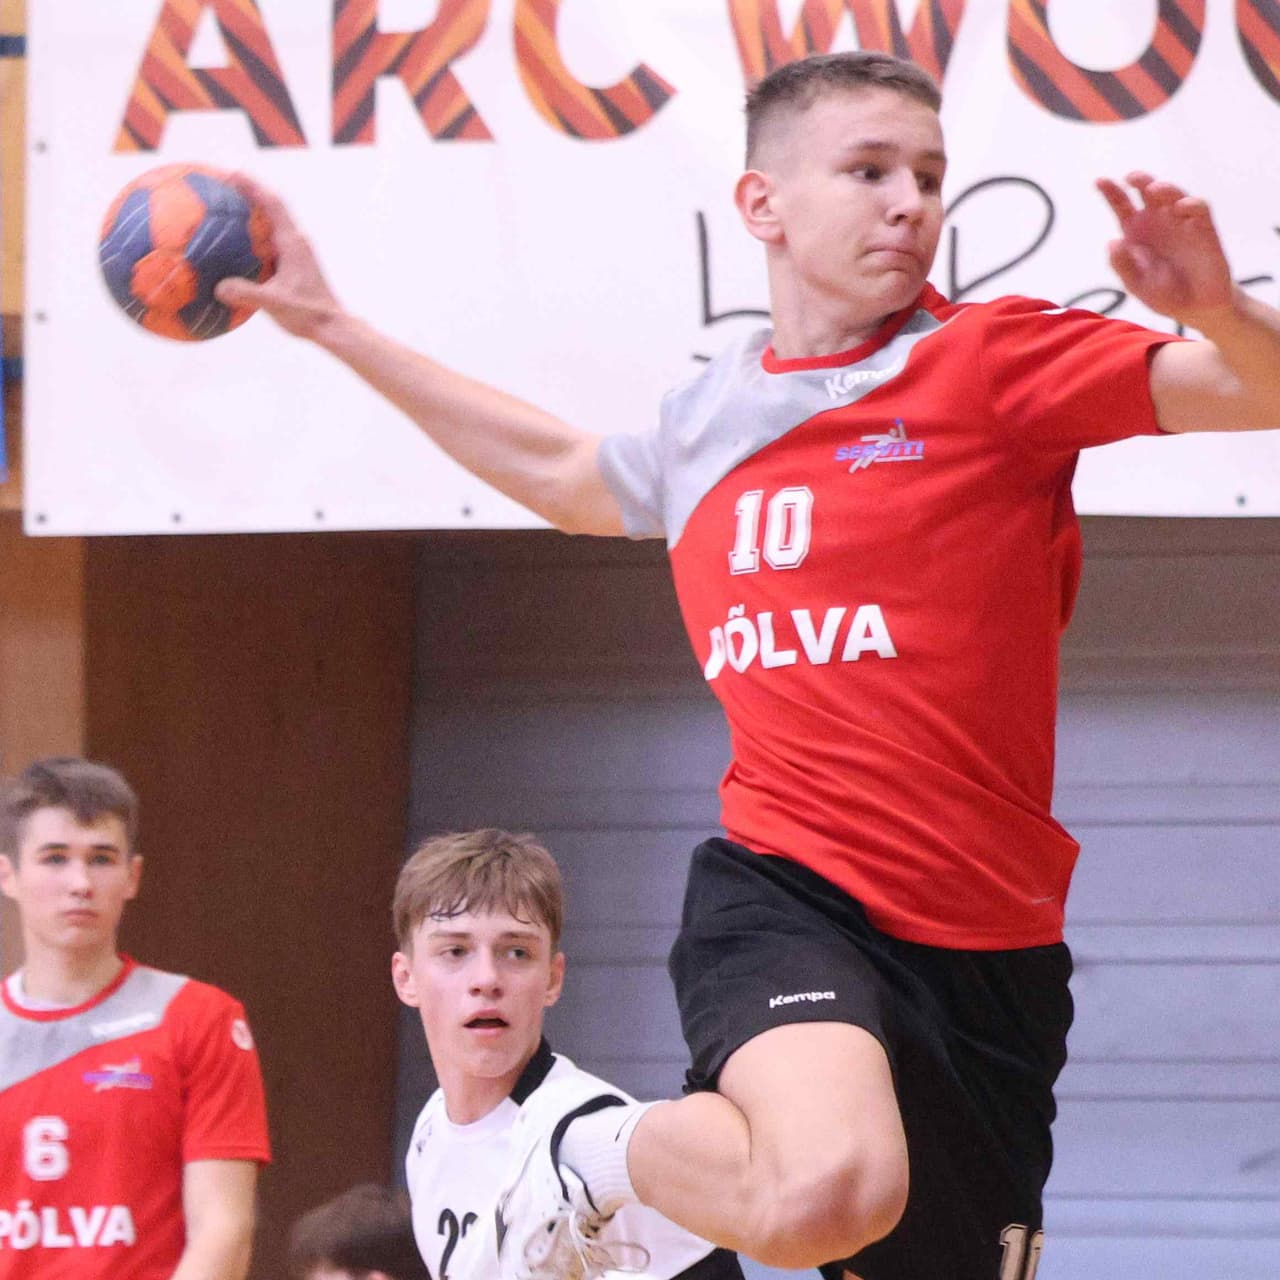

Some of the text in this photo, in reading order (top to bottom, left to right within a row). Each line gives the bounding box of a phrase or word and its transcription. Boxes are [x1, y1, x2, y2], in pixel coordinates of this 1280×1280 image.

[728, 486, 814, 575] 10
[769, 991, 836, 1009] Kempa
[23, 1115, 70, 1181] 6
